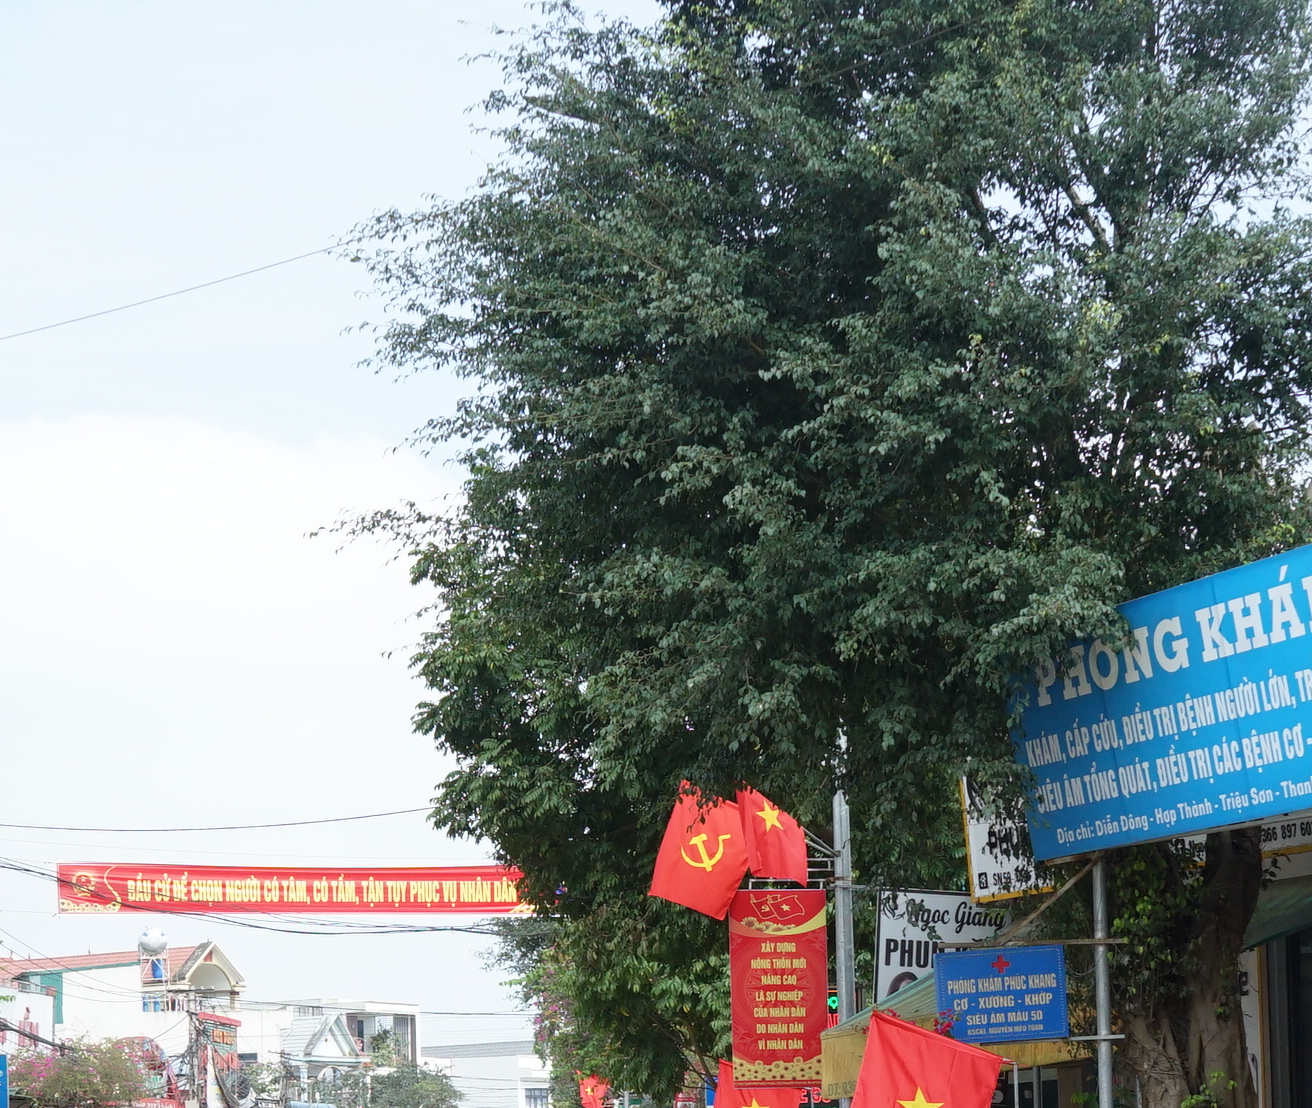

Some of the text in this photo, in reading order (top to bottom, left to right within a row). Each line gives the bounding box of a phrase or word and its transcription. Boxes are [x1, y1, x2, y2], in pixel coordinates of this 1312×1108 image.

[1025, 731, 1066, 768] KHÁM,
[1065, 717, 1090, 760] CẤP
[1092, 713, 1124, 753] CỨU,
[1122, 702, 1154, 745] ĐIỀU
[1153, 704, 1179, 741] TRỊ
[1179, 693, 1215, 737] BỆNH
[1215, 676, 1261, 722] NGƯỜI
[1260, 668, 1297, 714] LỚN,
[1064, 774, 1086, 808] ÂM
[1084, 761, 1119, 804] TỔNG
[1118, 757, 1158, 798] QUÁT,
[1156, 744, 1189, 788] ĐIỀU
[1188, 748, 1212, 784] TRỊ
[1213, 736, 1242, 775] CÁC
[1241, 729, 1284, 773] BỆNH
[1284, 722, 1304, 759] CƠ
[1056, 826, 1075, 848] Địa
[1095, 813, 1119, 838] Diễn
[1119, 811, 1149, 835] Đông
[1155, 808, 1177, 829] Hợp
[1177, 798, 1213, 820] Thành
[1219, 790, 1249, 813] Triệu
[1251, 788, 1274, 804] Sơn
[1281, 822, 1297, 839] 897
[127, 871, 517, 907] BẦU CỬ ĐỂ CHỌN NGƯỜI CÓ TÂM, CÓ TẦM, TẬN TỤY PHỤC VỤ NHÂN DÂN
[955, 901, 1007, 934] Giang
[761, 940, 796, 955] XÂY DỰNG
[751, 956, 806, 969] NÔNG THÔN MỚI
[761, 972, 797, 985] NÂNG CAO
[947, 973, 1057, 995] PHÒNG KHÁM PHÚC KHANG
[755, 989, 803, 1003] LÀ SỰ NGHIỆP
[953, 991, 1053, 1011] CƠ XƯƠNG KHỚP
[753, 1005, 806, 1017] CỦA NHÂN DÂN
[966, 1009, 1043, 1026] SIÊU ÂM MÀU 5D
[756, 1021, 804, 1033] DO NHÂN DÂN
[758, 1037, 803, 1050] VÌ NHÂN DÂN
